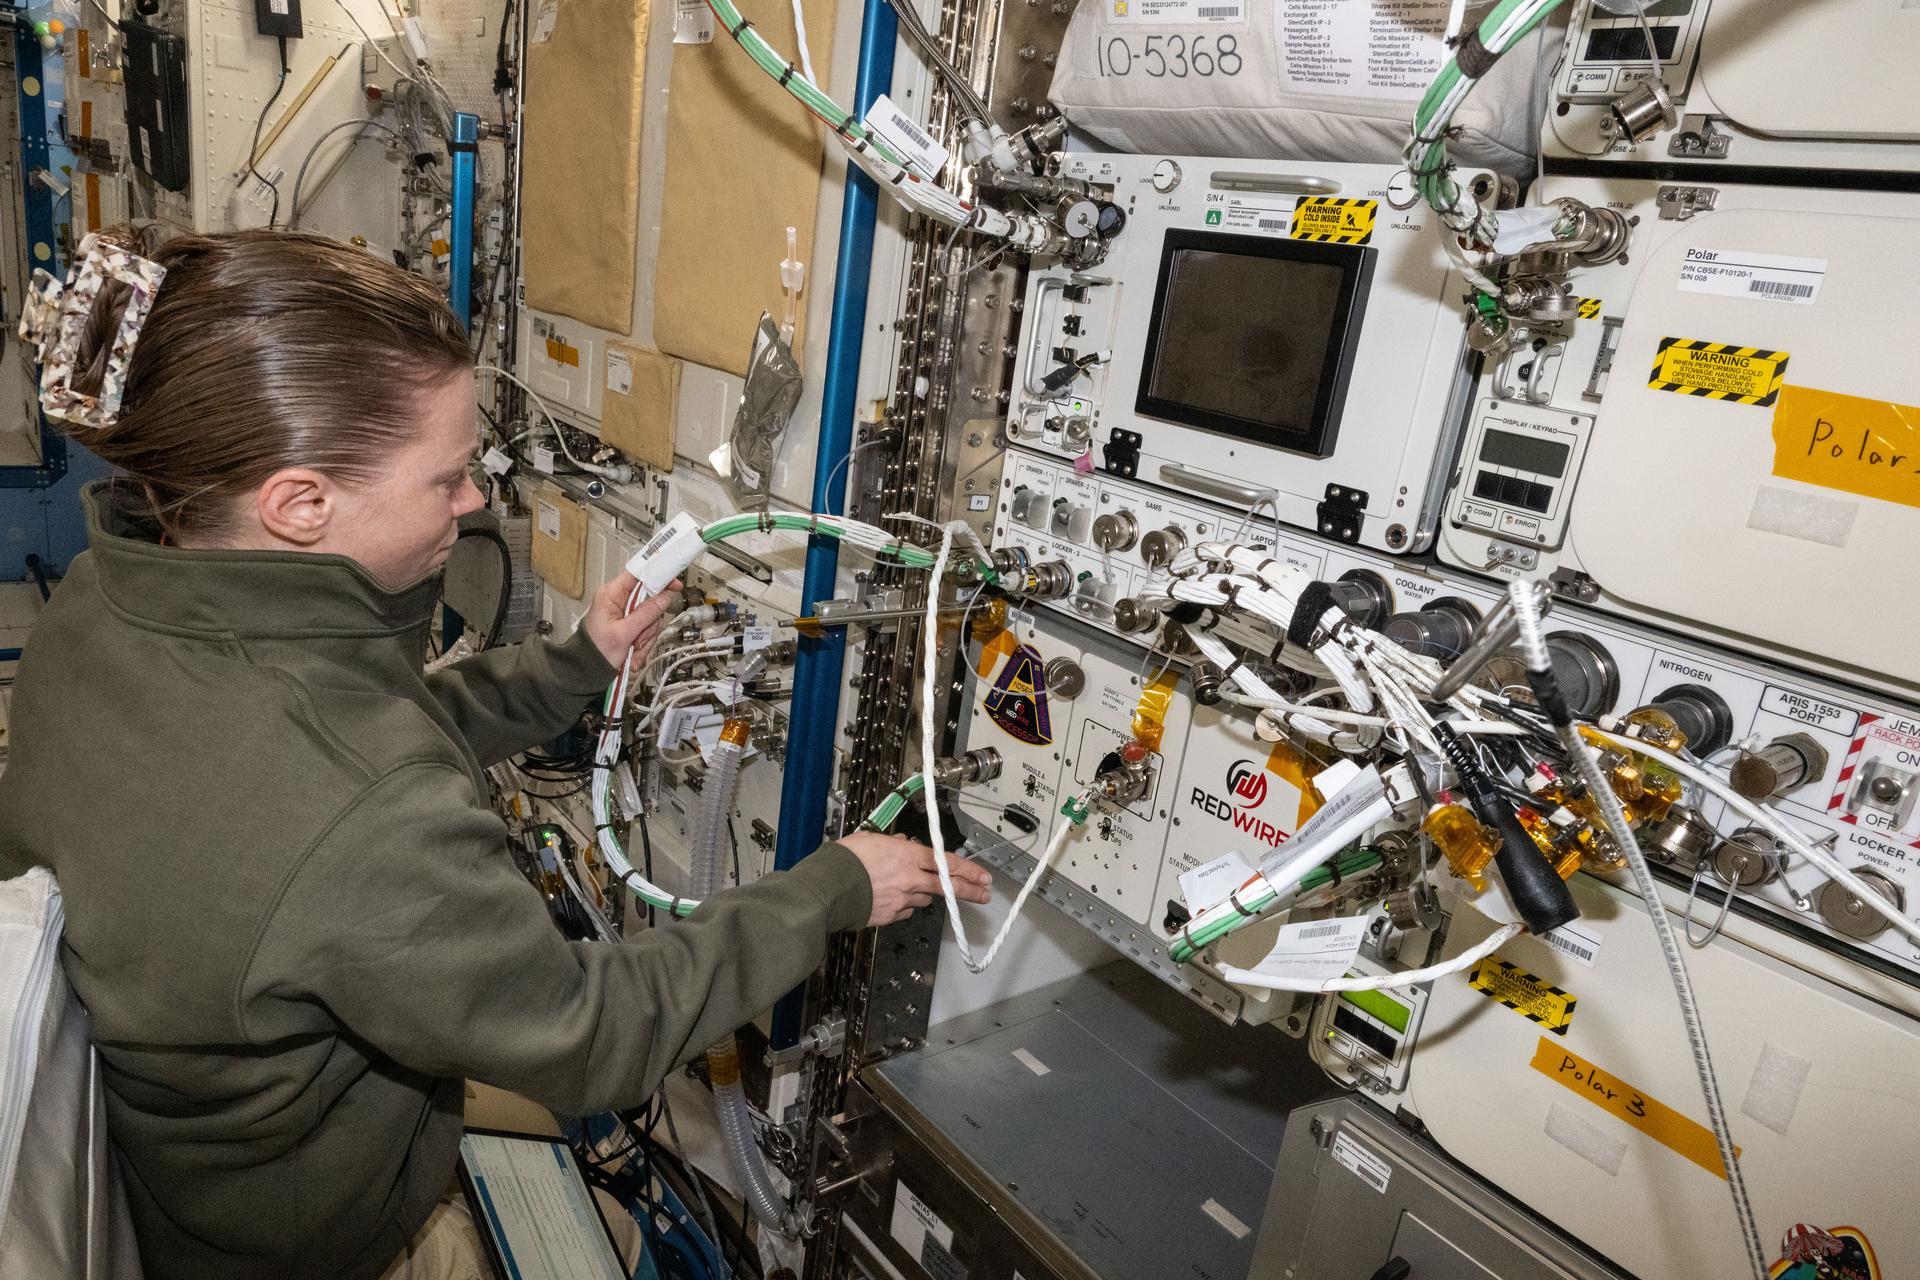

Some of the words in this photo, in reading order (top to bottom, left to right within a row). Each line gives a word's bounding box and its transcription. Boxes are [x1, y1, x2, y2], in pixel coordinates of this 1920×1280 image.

[1206, 194, 1218, 202] S/N
[1305, 205, 1342, 215] WARNING
[1304, 213, 1319, 222] COLD
[1320, 214, 1341, 223] INSIDE
[1686, 248, 1718, 261] Polar
[1696, 266, 1752, 278] CBSE-F10120-1
[1690, 351, 1750, 368] WARNING
[1673, 358, 1694, 367] WHEN
[1695, 361, 1741, 375] PERFORMING
[1742, 369, 1763, 377] COLD
[1679, 365, 1714, 376] STOWAGE
[1715, 370, 1752, 382] HANDLING
[1672, 371, 1716, 383] OPERATIONS
[1717, 377, 1744, 387] BELOW
[1687, 380, 1706, 388] HAND
[1707, 383, 1753, 394] PROTECTION
[1503, 418, 1528, 428] DISPLAY
[1532, 424, 1558, 434] KEYPAD
[1808, 418, 1907, 467] Polar
[1145, 501, 1162, 512] SAMS
[1474, 508, 1492, 518] COMM
[1515, 518, 1537, 529] ERROR
[1052, 542, 1073, 554] LOCKER
[1287, 558, 1300, 566] DATA
[1500, 567, 1513, 575] GSE
[1395, 578, 1435, 596] COOLANT
[1404, 590, 1422, 600] WATER
[1659, 659, 1712, 682] NITROGEN
[1779, 693, 1809, 711] ARIS
[1813, 702, 1842, 719] 1553
[1789, 707, 1824, 726] PORT
[1874, 728, 1903, 742] RACK
[1022, 762, 1040, 778] MODULE
[1037, 781, 1055, 796] STATUS
[1035, 791, 1045, 802] OPS
[1020, 800, 1035, 815] DEBUG
[1191, 787, 1292, 848] REDWIRE
[1865, 813, 1897, 830] OFF
[1111, 835, 1122, 847] OPS
[1113, 825, 1134, 842] STATUS
[1849, 832, 1906, 861] LOCKER
[1858, 852, 1890, 868] POWER
[1500, 969, 1546, 996] WARNING
[1514, 1000, 1549, 1019] PROTECTION
[1541, 998, 1556, 1008] COLD
[1559, 1055, 1618, 1100] Polar
[1625, 1094, 1646, 1117] 3
